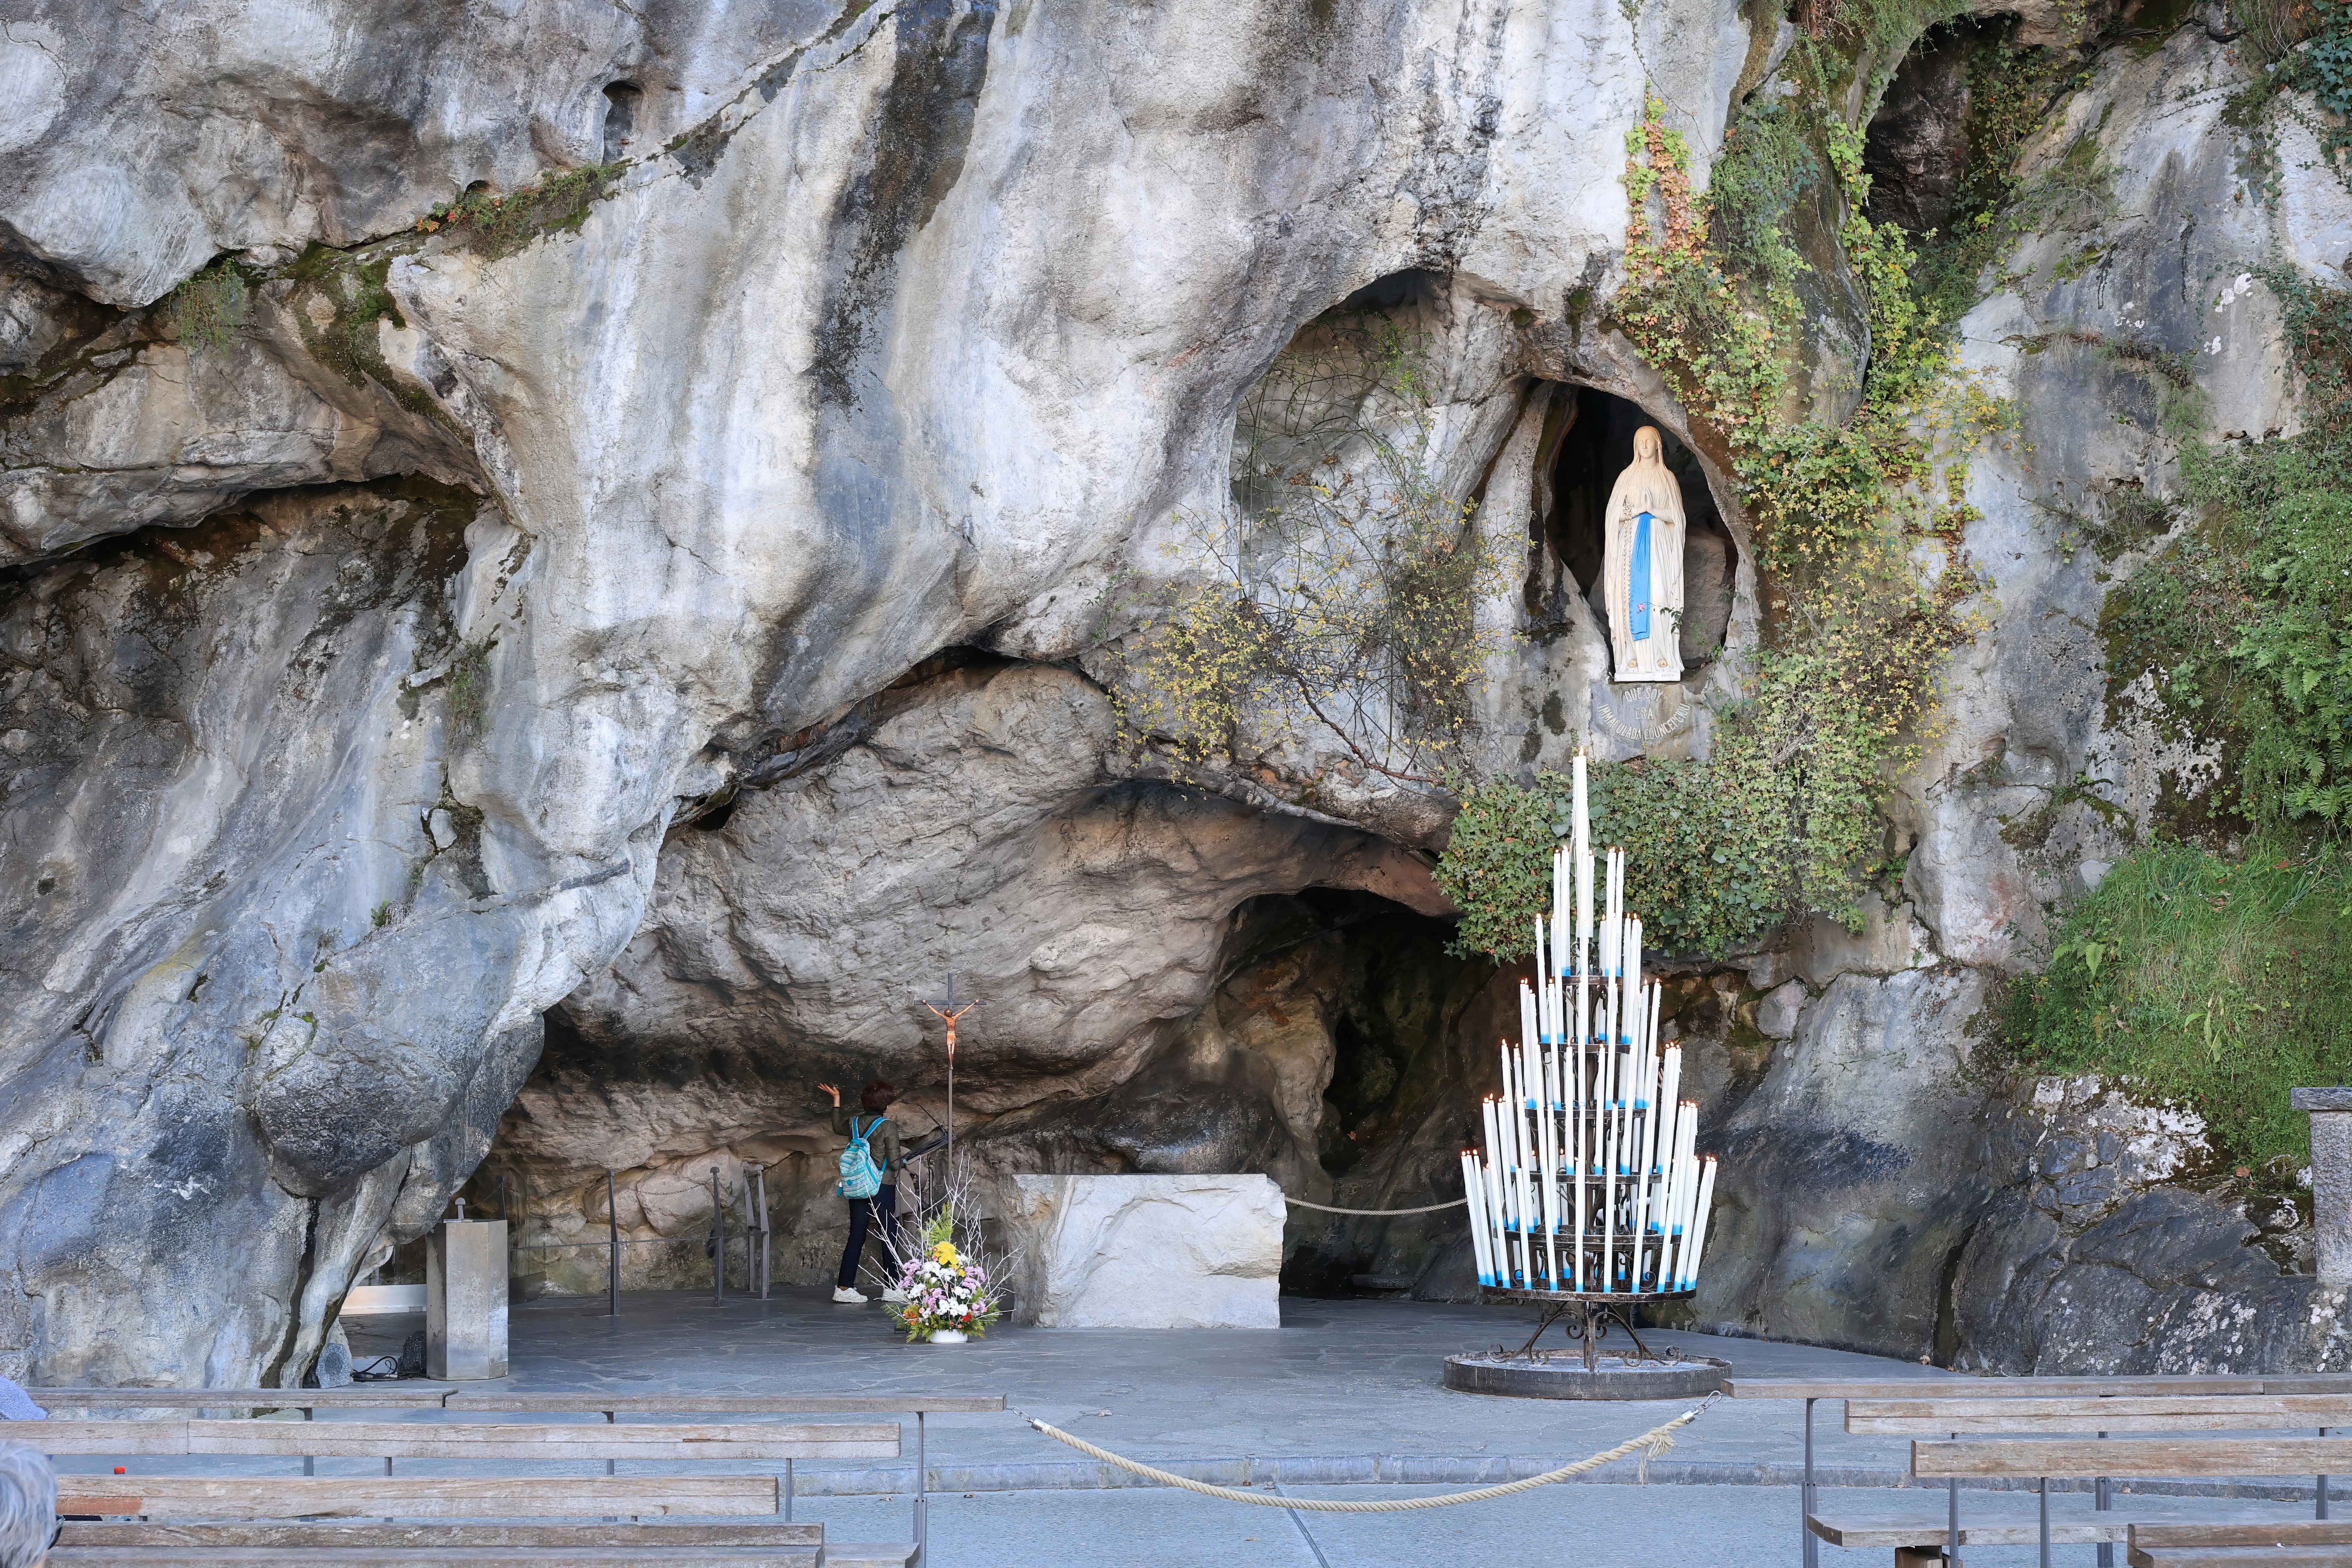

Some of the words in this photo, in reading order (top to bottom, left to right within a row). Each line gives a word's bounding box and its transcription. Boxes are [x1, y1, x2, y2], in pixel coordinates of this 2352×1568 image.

[1624, 687, 1643, 702] QUE
[1645, 687, 1663, 702] SOY
[1597, 704, 1642, 740] IMMACULADA
[1644, 703, 1690, 740] COUNCEPCIOU
[1635, 708, 1654, 720] ERA
